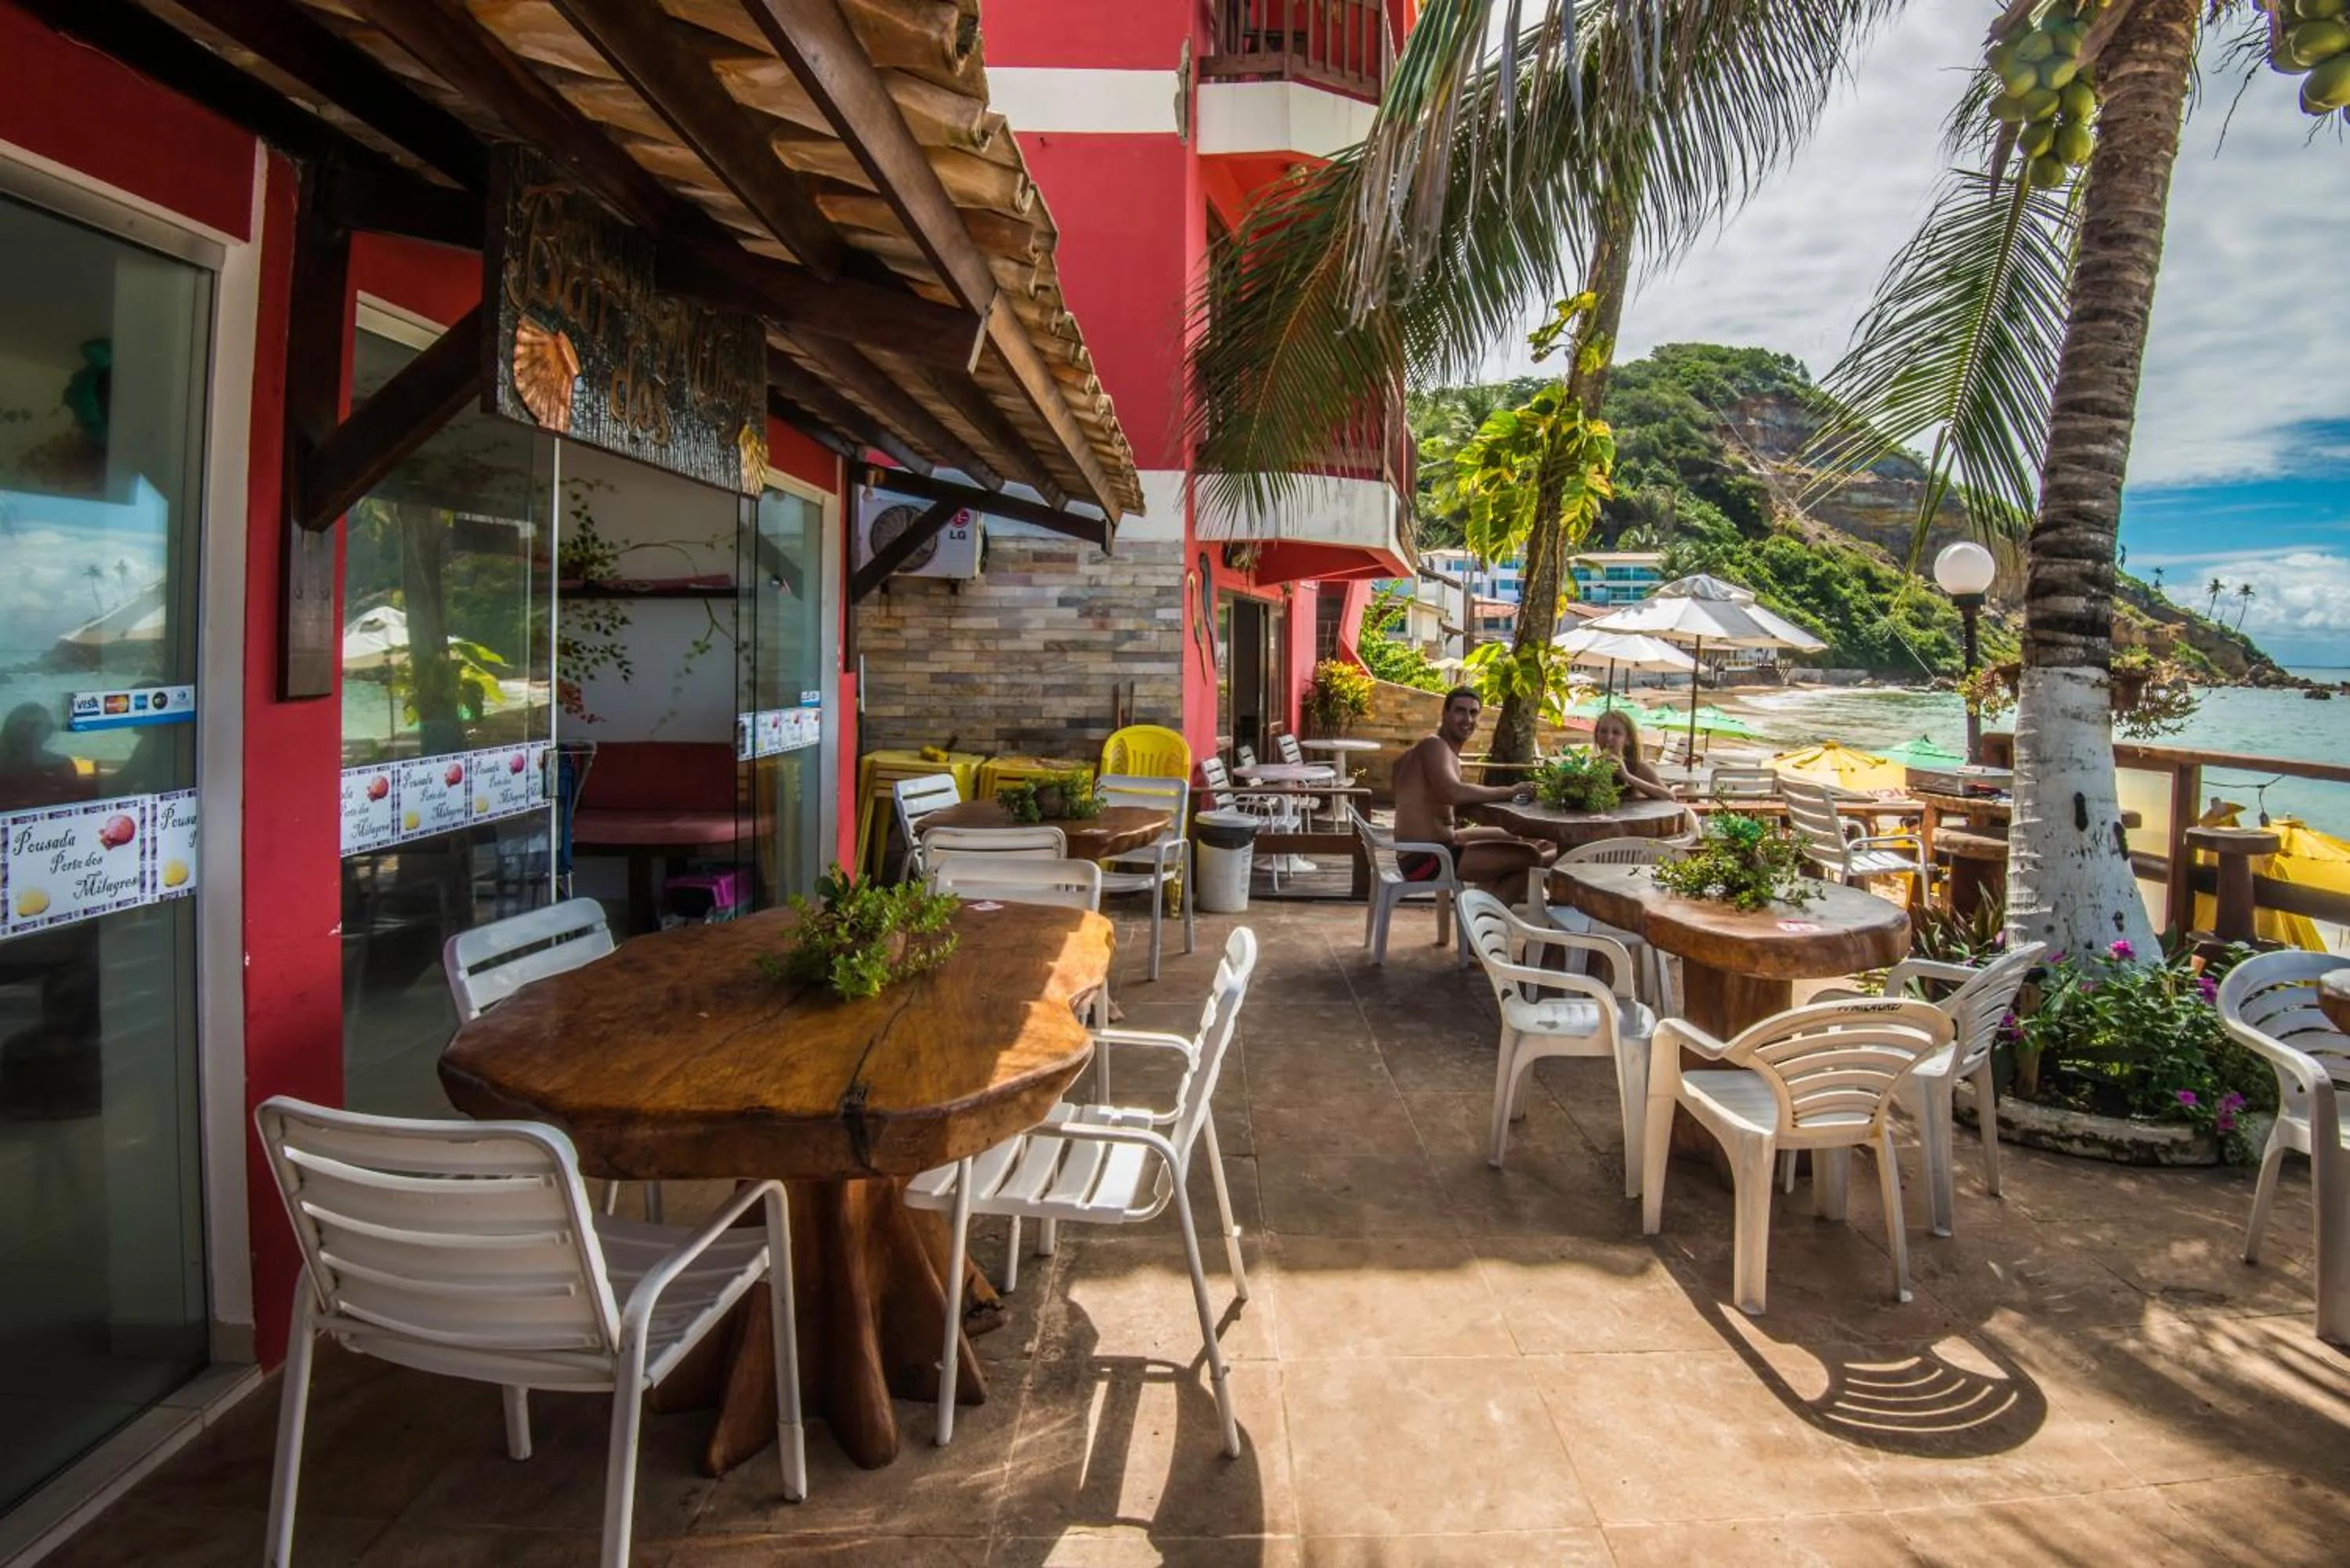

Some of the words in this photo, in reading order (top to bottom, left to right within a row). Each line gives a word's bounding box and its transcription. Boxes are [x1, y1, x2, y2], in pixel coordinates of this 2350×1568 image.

[949, 529, 966, 540] LG
[76, 697, 99, 710] VISA
[160, 803, 196, 830] Pousa
[13, 826, 76, 856] Pousada
[85, 851, 103, 867] dos
[73, 870, 138, 899] Milagres
